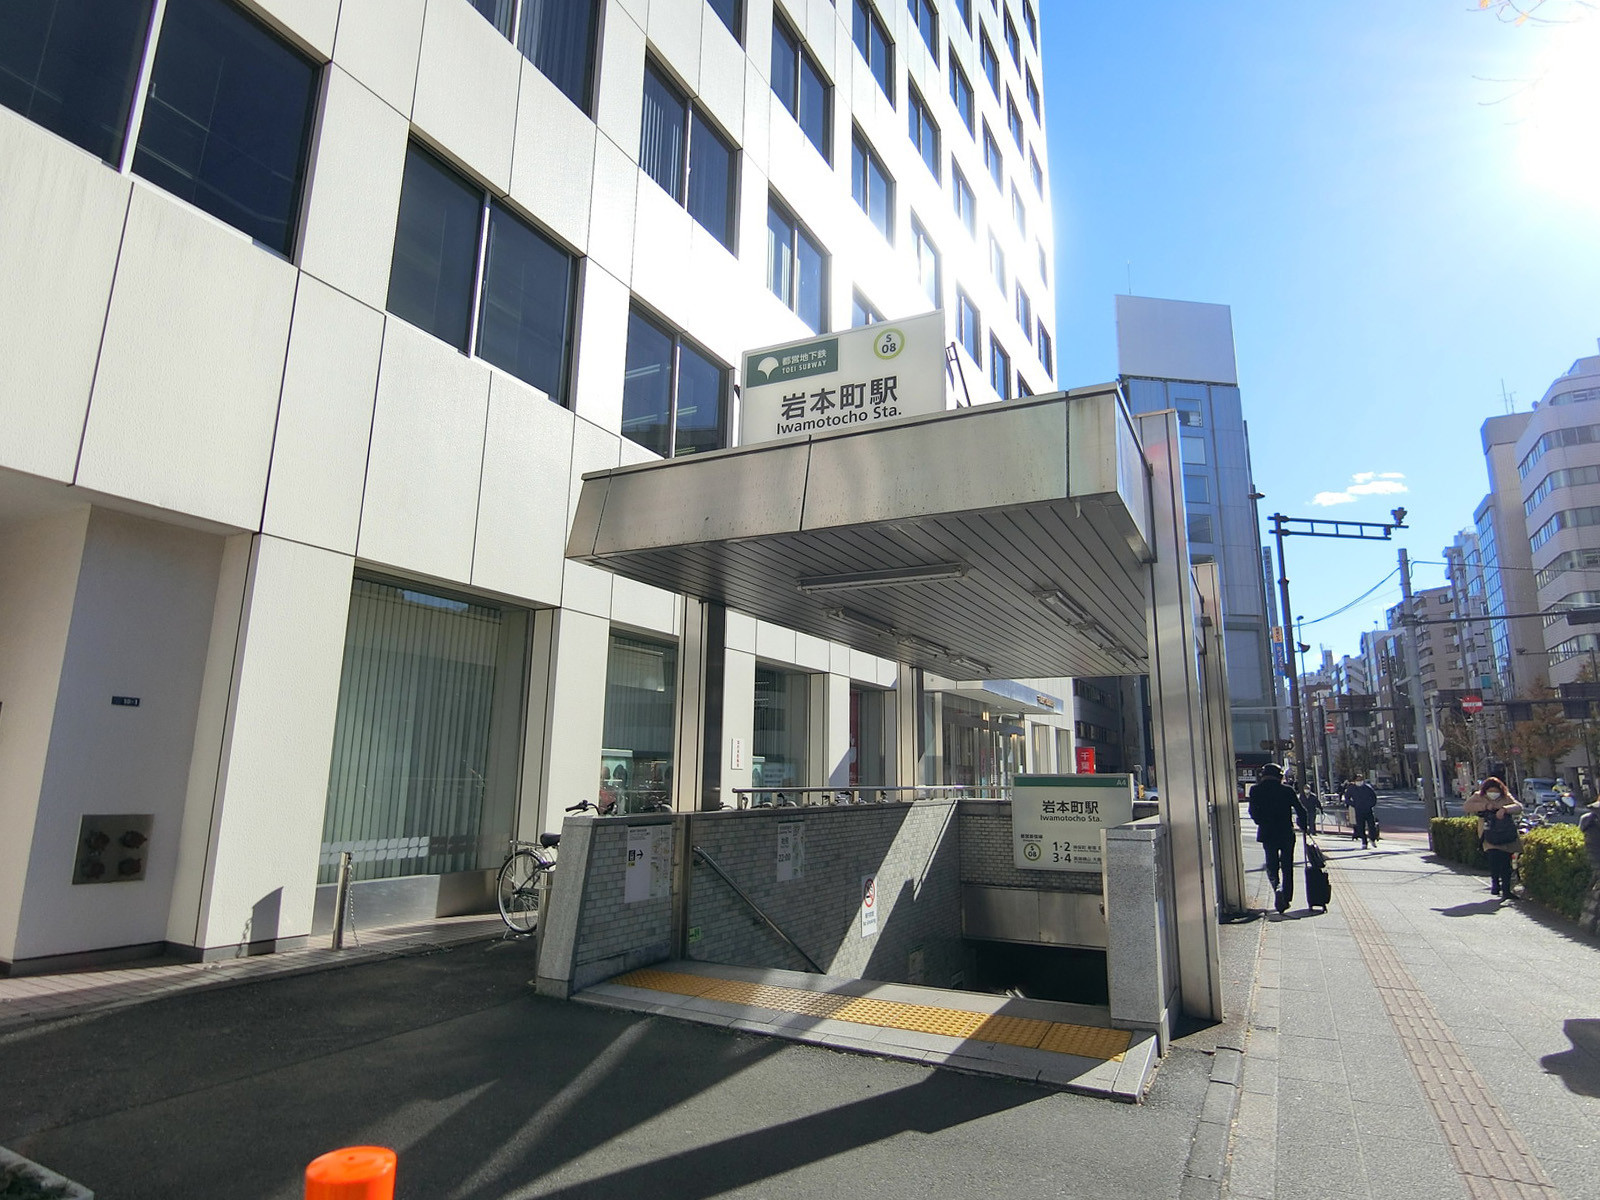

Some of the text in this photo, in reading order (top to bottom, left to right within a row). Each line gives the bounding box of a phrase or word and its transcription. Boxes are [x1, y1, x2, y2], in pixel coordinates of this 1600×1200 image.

[886, 334, 892, 343] S
[881, 342, 897, 354] 08
[782, 360, 827, 375] TOEI SUBWAY
[781, 375, 898, 421] 岩本町駅
[777, 404, 902, 435] Iwamotocho Sta.
[1042, 800, 1099, 814] 岩本町駅
[1040, 814, 1103, 823] Iwamotocho Sta.
